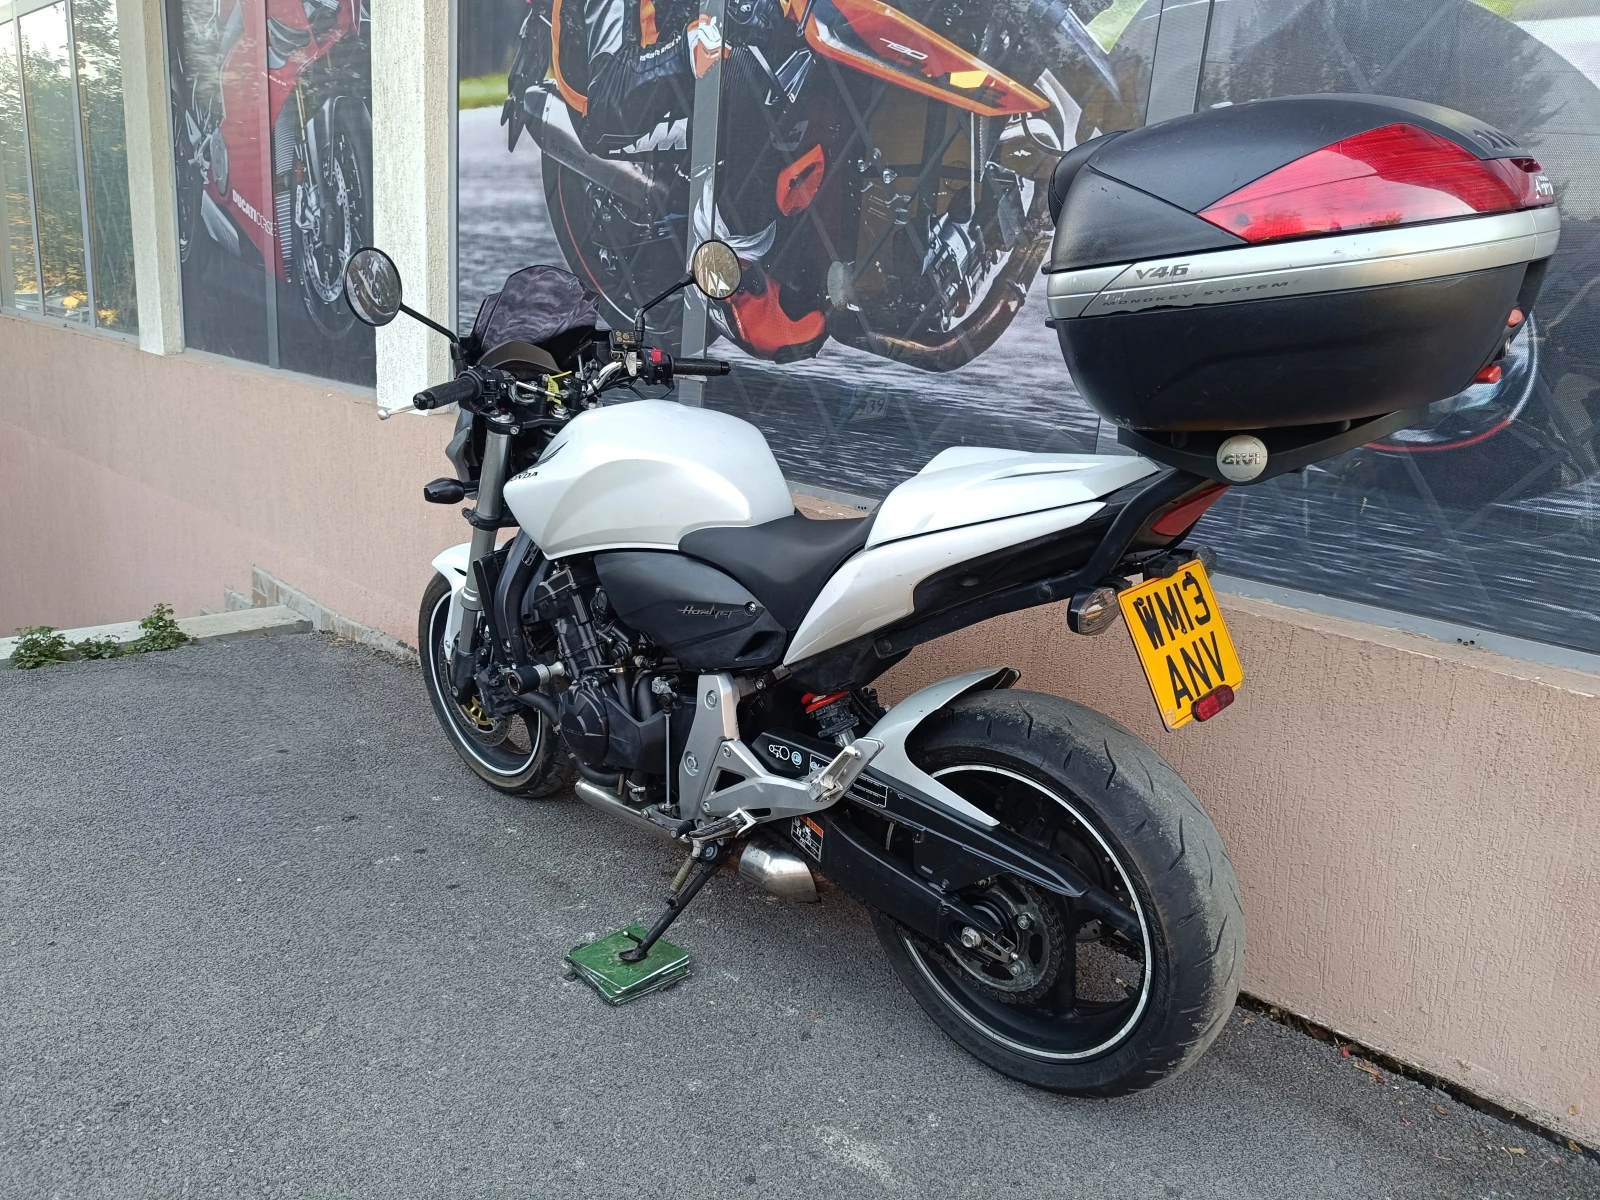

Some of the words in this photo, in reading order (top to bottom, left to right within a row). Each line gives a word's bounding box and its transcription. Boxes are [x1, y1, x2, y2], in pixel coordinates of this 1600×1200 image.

[1135, 263, 1190, 280] V46
[1103, 293, 1193, 307] MONOKEY
[1203, 281, 1290, 297] SYSTEM
[1221, 452, 1261, 467] GIVI
[1132, 571, 1211, 650] WM13
[1165, 631, 1226, 709] ANV
